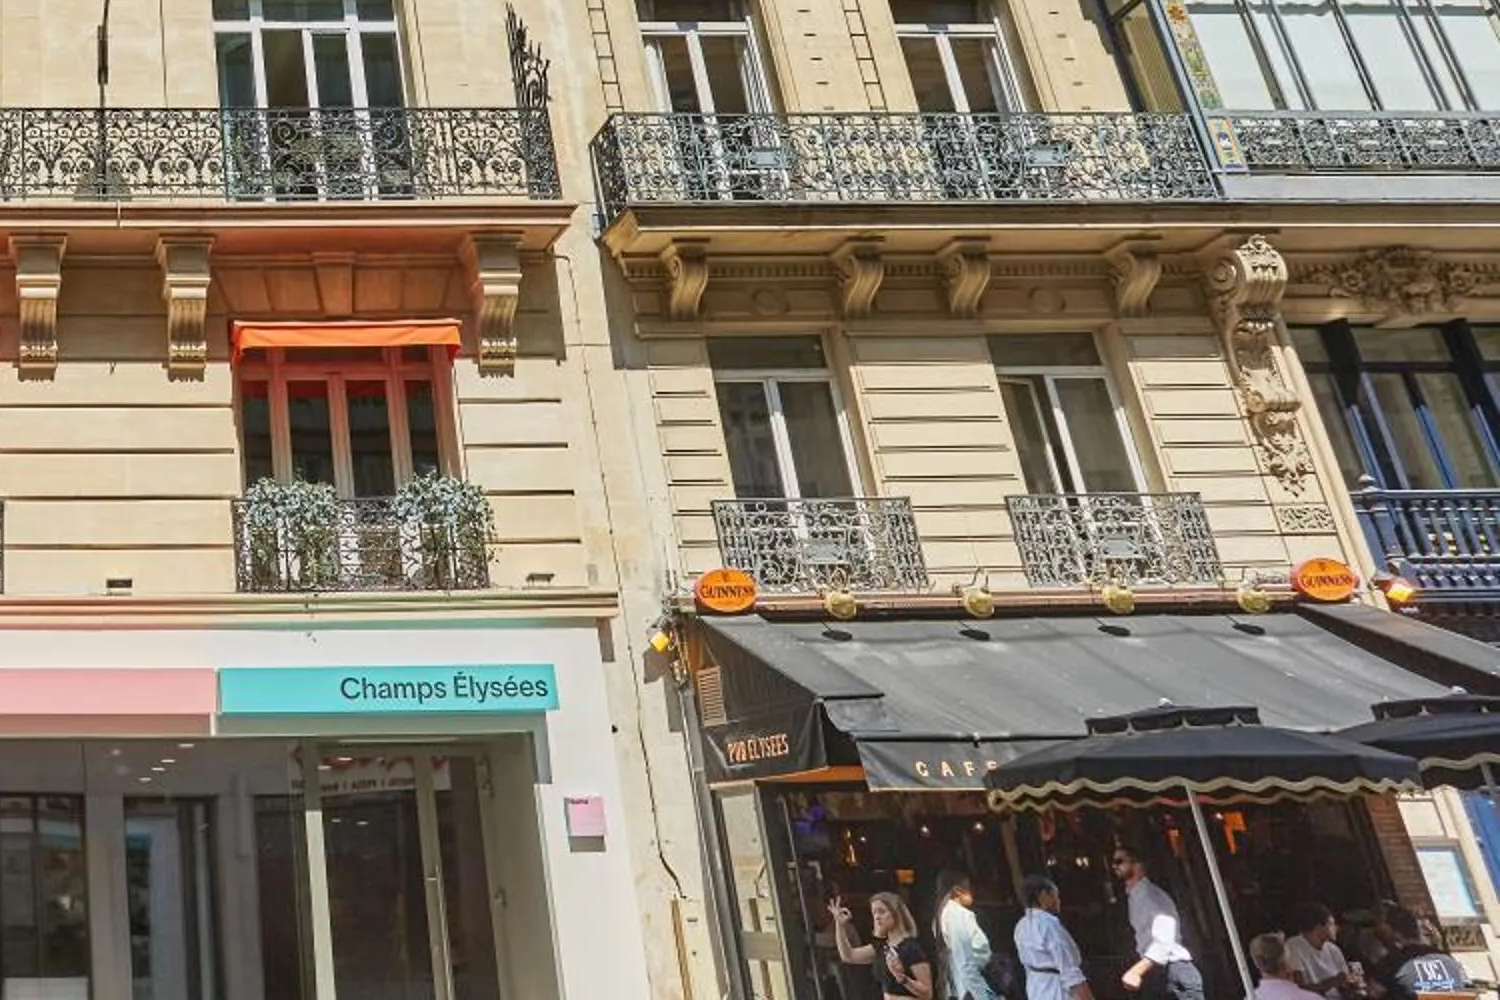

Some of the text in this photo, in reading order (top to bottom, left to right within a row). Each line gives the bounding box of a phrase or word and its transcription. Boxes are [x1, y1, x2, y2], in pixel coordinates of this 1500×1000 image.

[700, 584, 753, 599] GUINNESS
[340, 671, 549, 704] Champs Élysées
